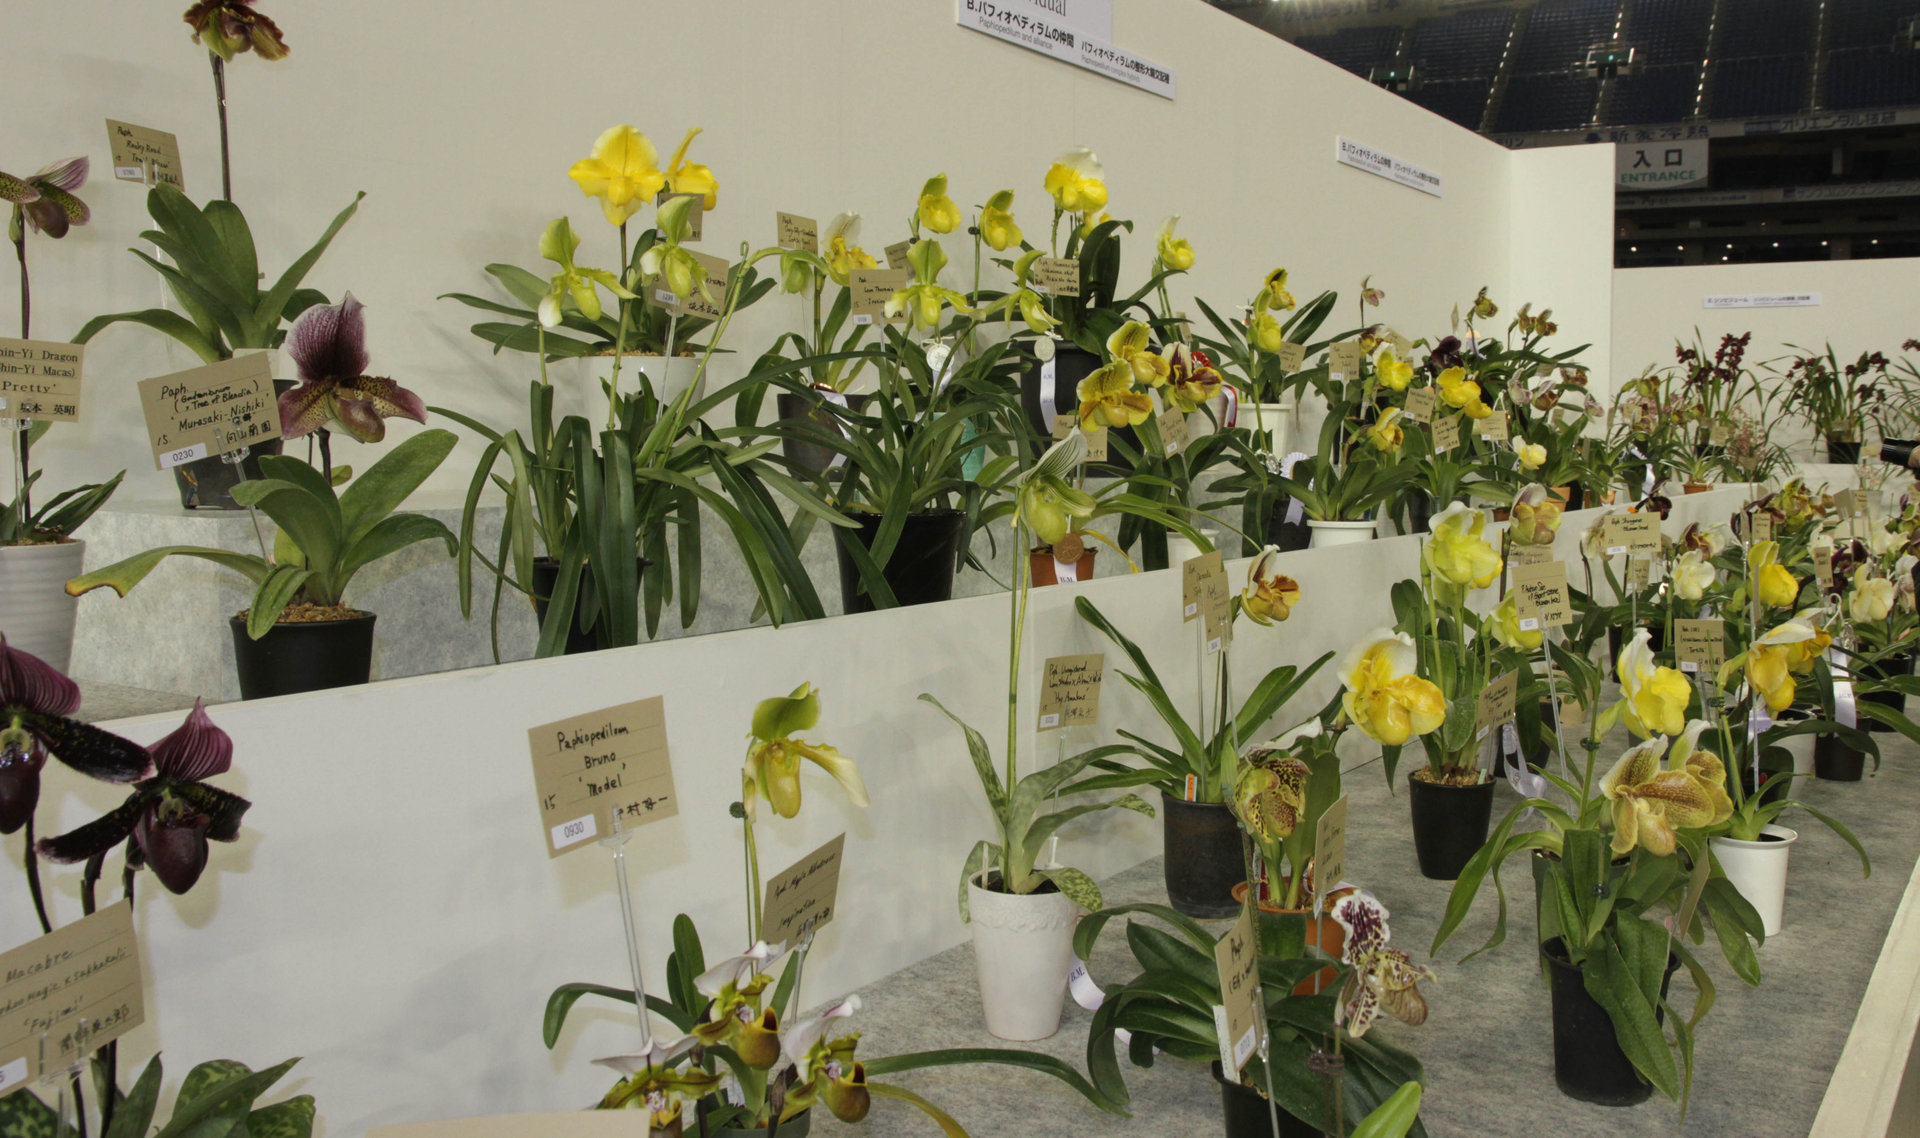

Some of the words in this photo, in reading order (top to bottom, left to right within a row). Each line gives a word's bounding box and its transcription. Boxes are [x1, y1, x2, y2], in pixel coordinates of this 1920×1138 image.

[1633, 149, 1683, 168] 入口
[1621, 170, 1696, 183] ENTRANCE
[42, 350, 78, 362] Dragon
[43, 366, 76, 378] Macas)
[173, 449, 193, 462] 0230
[584, 752, 616, 769] Bruno
[564, 822, 584, 838] 0930
